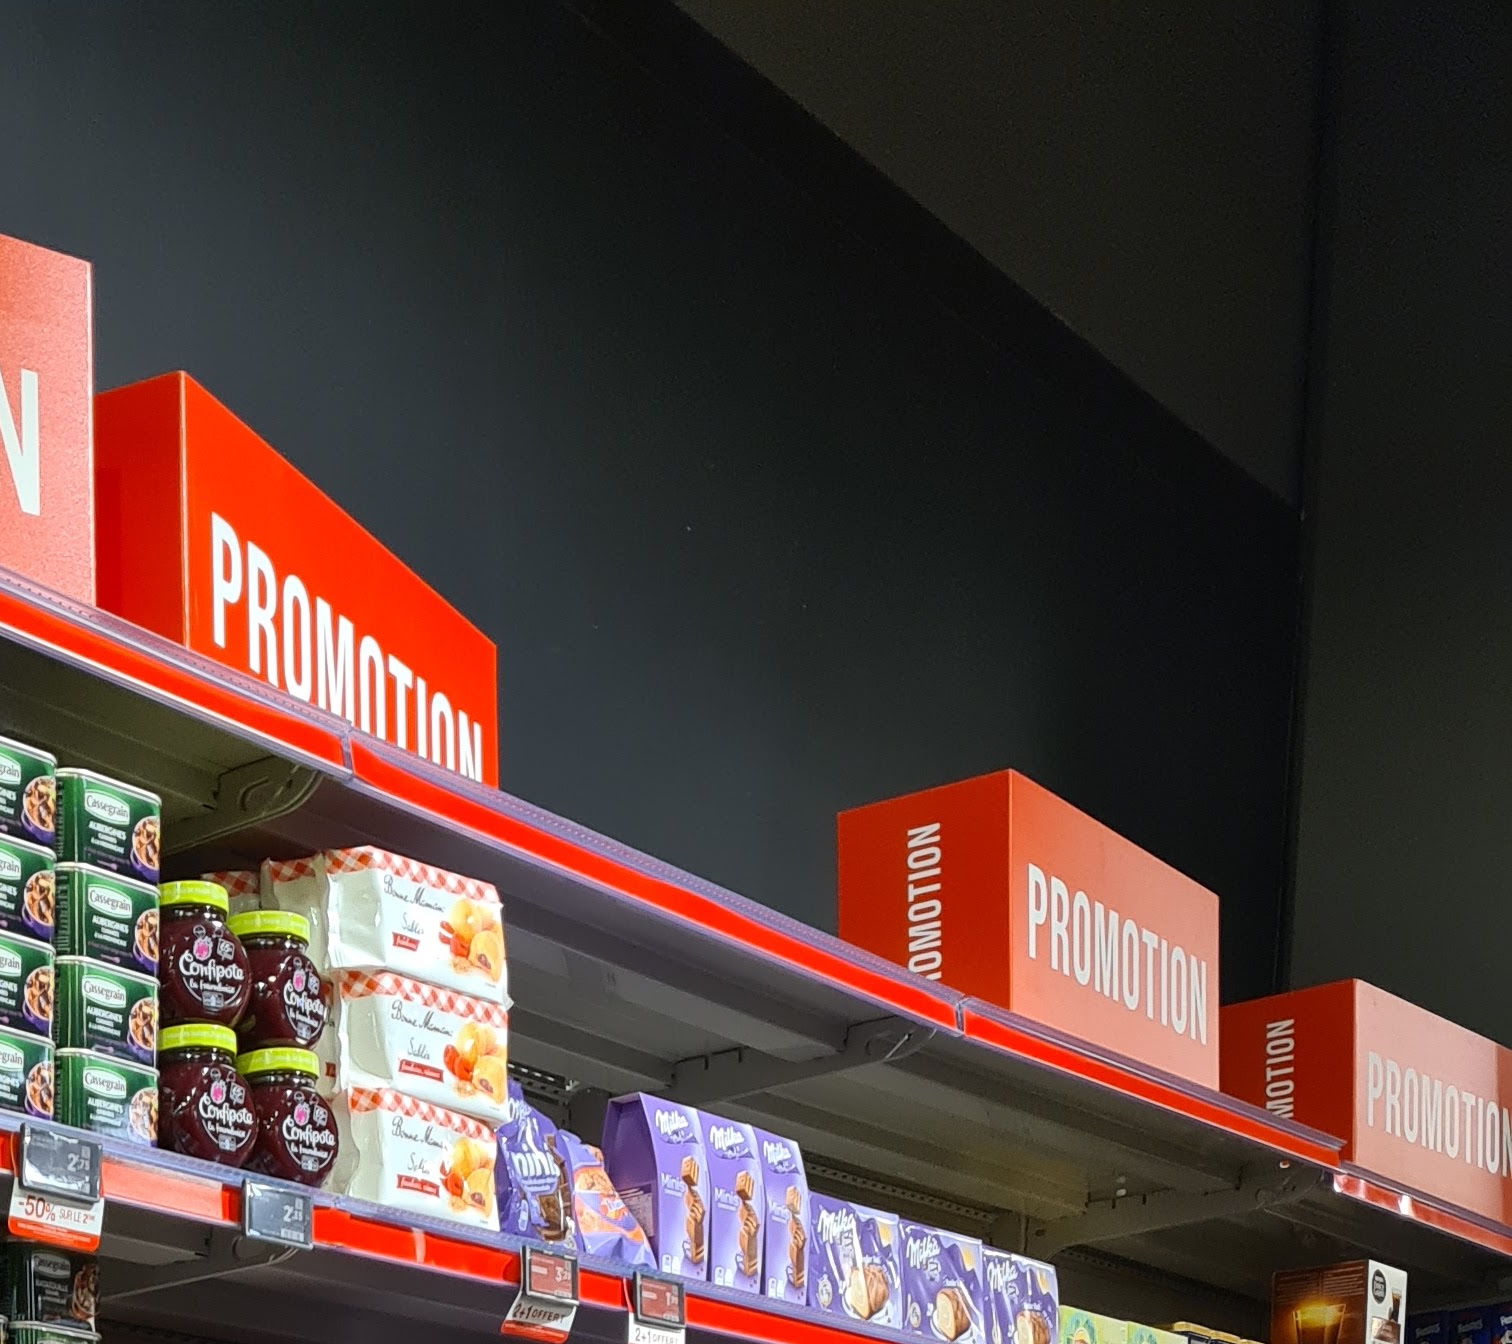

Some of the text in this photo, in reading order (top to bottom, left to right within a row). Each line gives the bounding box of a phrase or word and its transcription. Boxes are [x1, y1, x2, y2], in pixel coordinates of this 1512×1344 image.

[210, 511, 483, 783] PROMOTION
[908, 822, 941, 980] OMOTION
[179, 949, 245, 983] Confipote
[1028, 863, 1207, 1046] PROMOTION
[1266, 1019, 1295, 1119] MOTION
[656, 1108, 690, 1137] Milka
[660, 1172, 685, 1192] Minis
